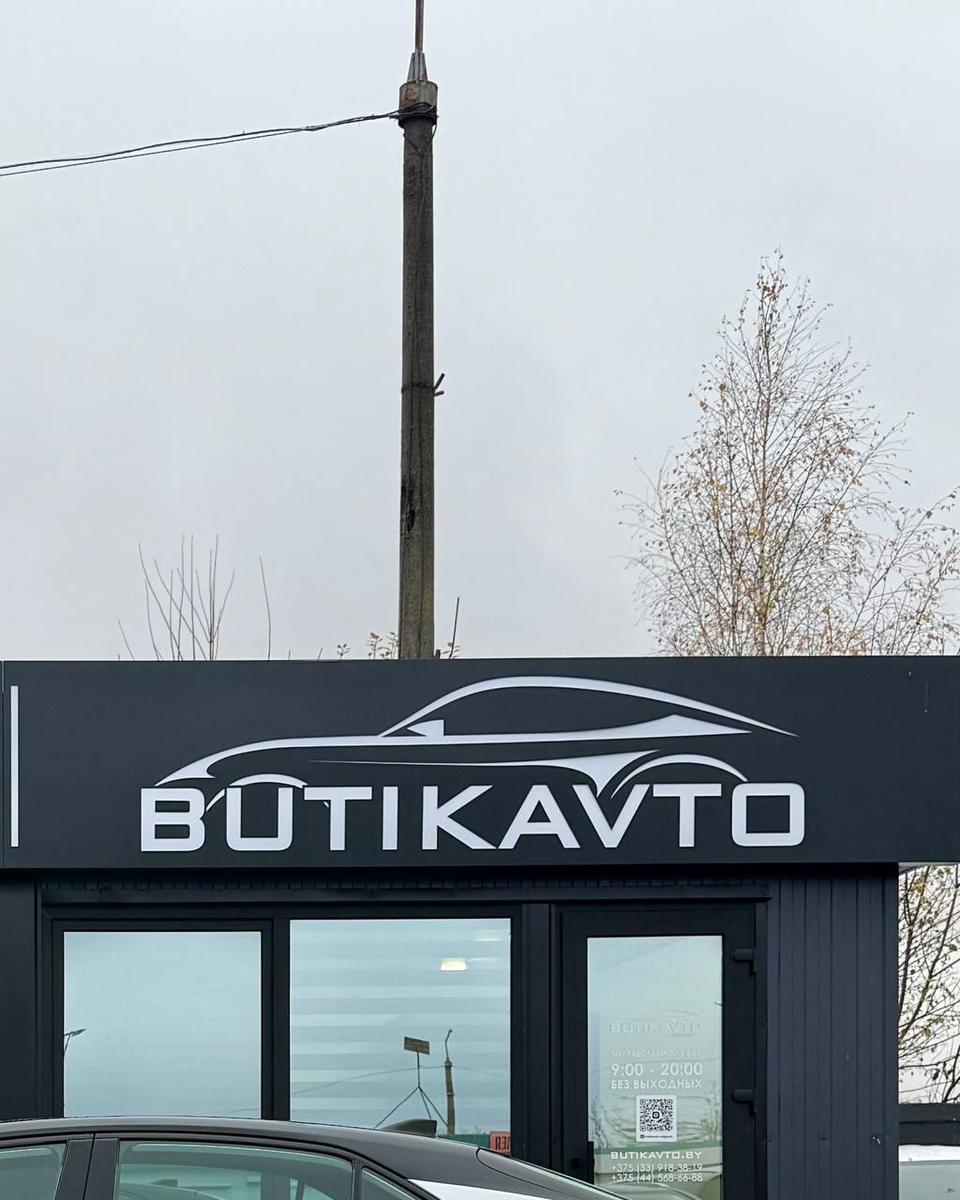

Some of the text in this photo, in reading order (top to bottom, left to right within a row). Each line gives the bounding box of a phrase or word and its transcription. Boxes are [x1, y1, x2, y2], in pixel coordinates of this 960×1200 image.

[140, 782, 806, 852] BUTIKAVTO
[611, 1063, 644, 1077] 9:00
[660, 1062, 703, 1076] 20:00
[611, 1079, 703, 1090] БЕЗ ВЫХОДНЫХ
[610, 1151, 703, 1160] BUTIKAVTO.BY
[612, 1163, 703, 1173] +375 (33) 918-38-19
[612, 1173, 703, 1183] +375 (44) 568-66-88
